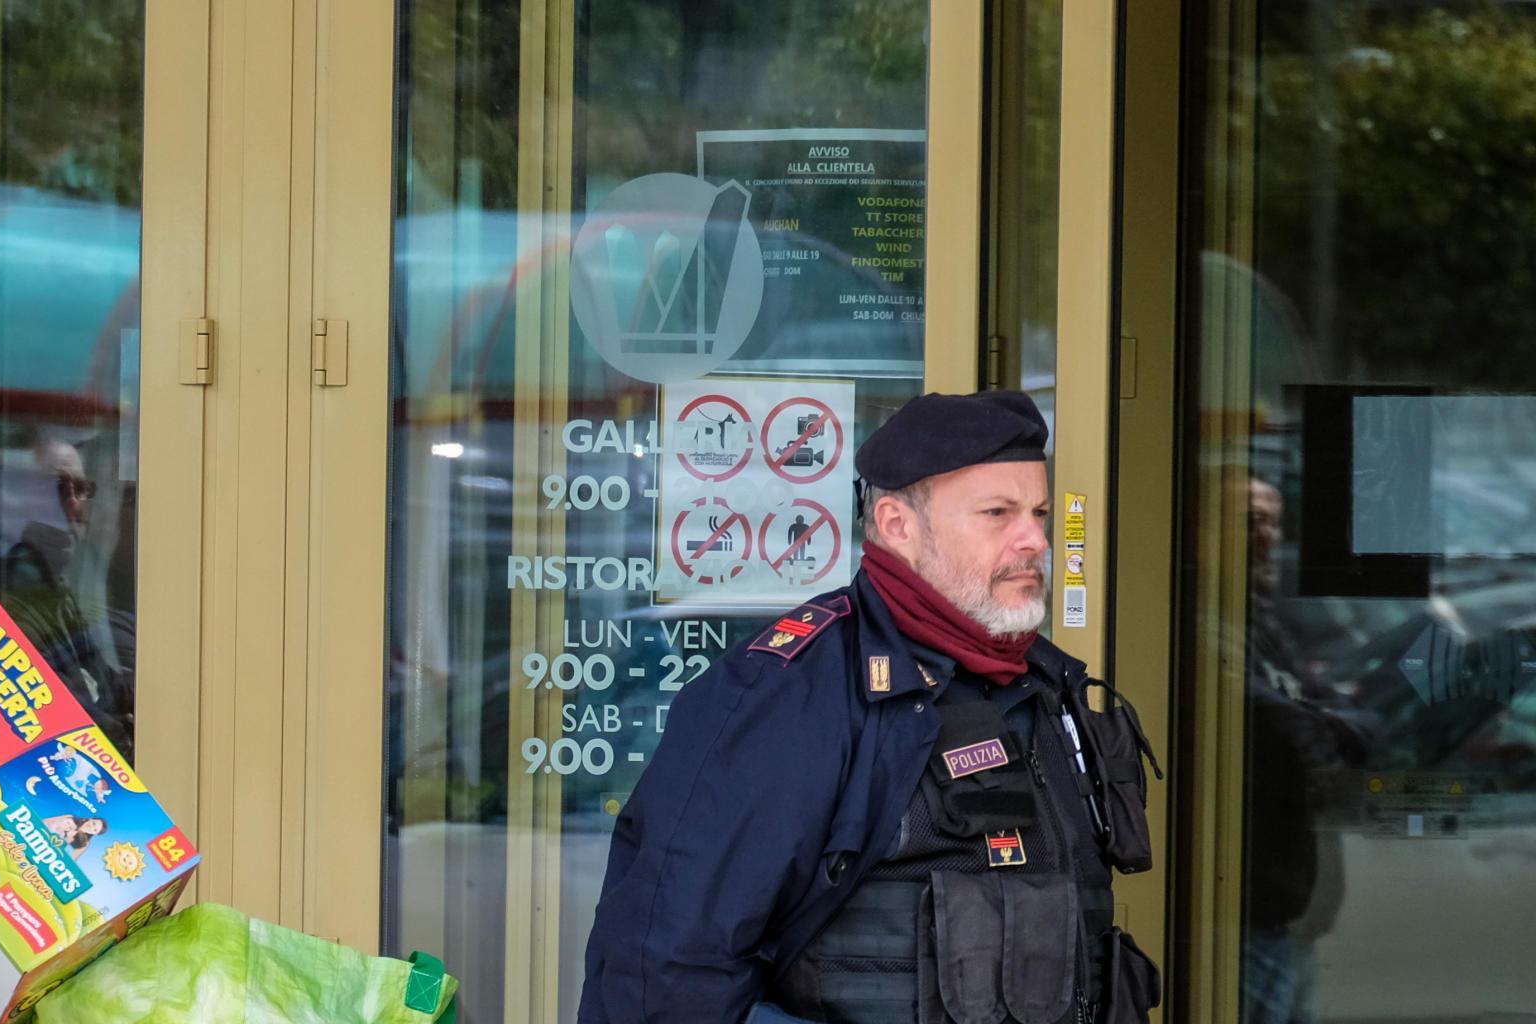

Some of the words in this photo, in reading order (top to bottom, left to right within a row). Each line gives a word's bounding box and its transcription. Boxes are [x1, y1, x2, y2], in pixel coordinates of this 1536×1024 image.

[808, 147, 850, 158] AVVISO
[787, 162, 811, 174] ALLA
[816, 162, 875, 174] CLIENTELA
[857, 197, 927, 208] VODAFONE
[865, 212, 881, 222] TT
[884, 212, 924, 223] STORE
[876, 242, 912, 253] WIND
[810, 250, 820, 260] 19
[880, 272, 904, 282] TIM
[877, 295, 904, 305] DALLE
[853, 311, 894, 320] SAB-DOM
[542, 475, 631, 512] 9.00
[564, 619, 632, 648] LUN
[659, 620, 727, 650] VEN
[521, 653, 615, 691] 9.00
[561, 703, 622, 733] SAB
[521, 737, 614, 776] 9.00
[950, 746, 1003, 771] POLIZIA
[5, 804, 81, 894] Pampers
[159, 835, 185, 862] 84
